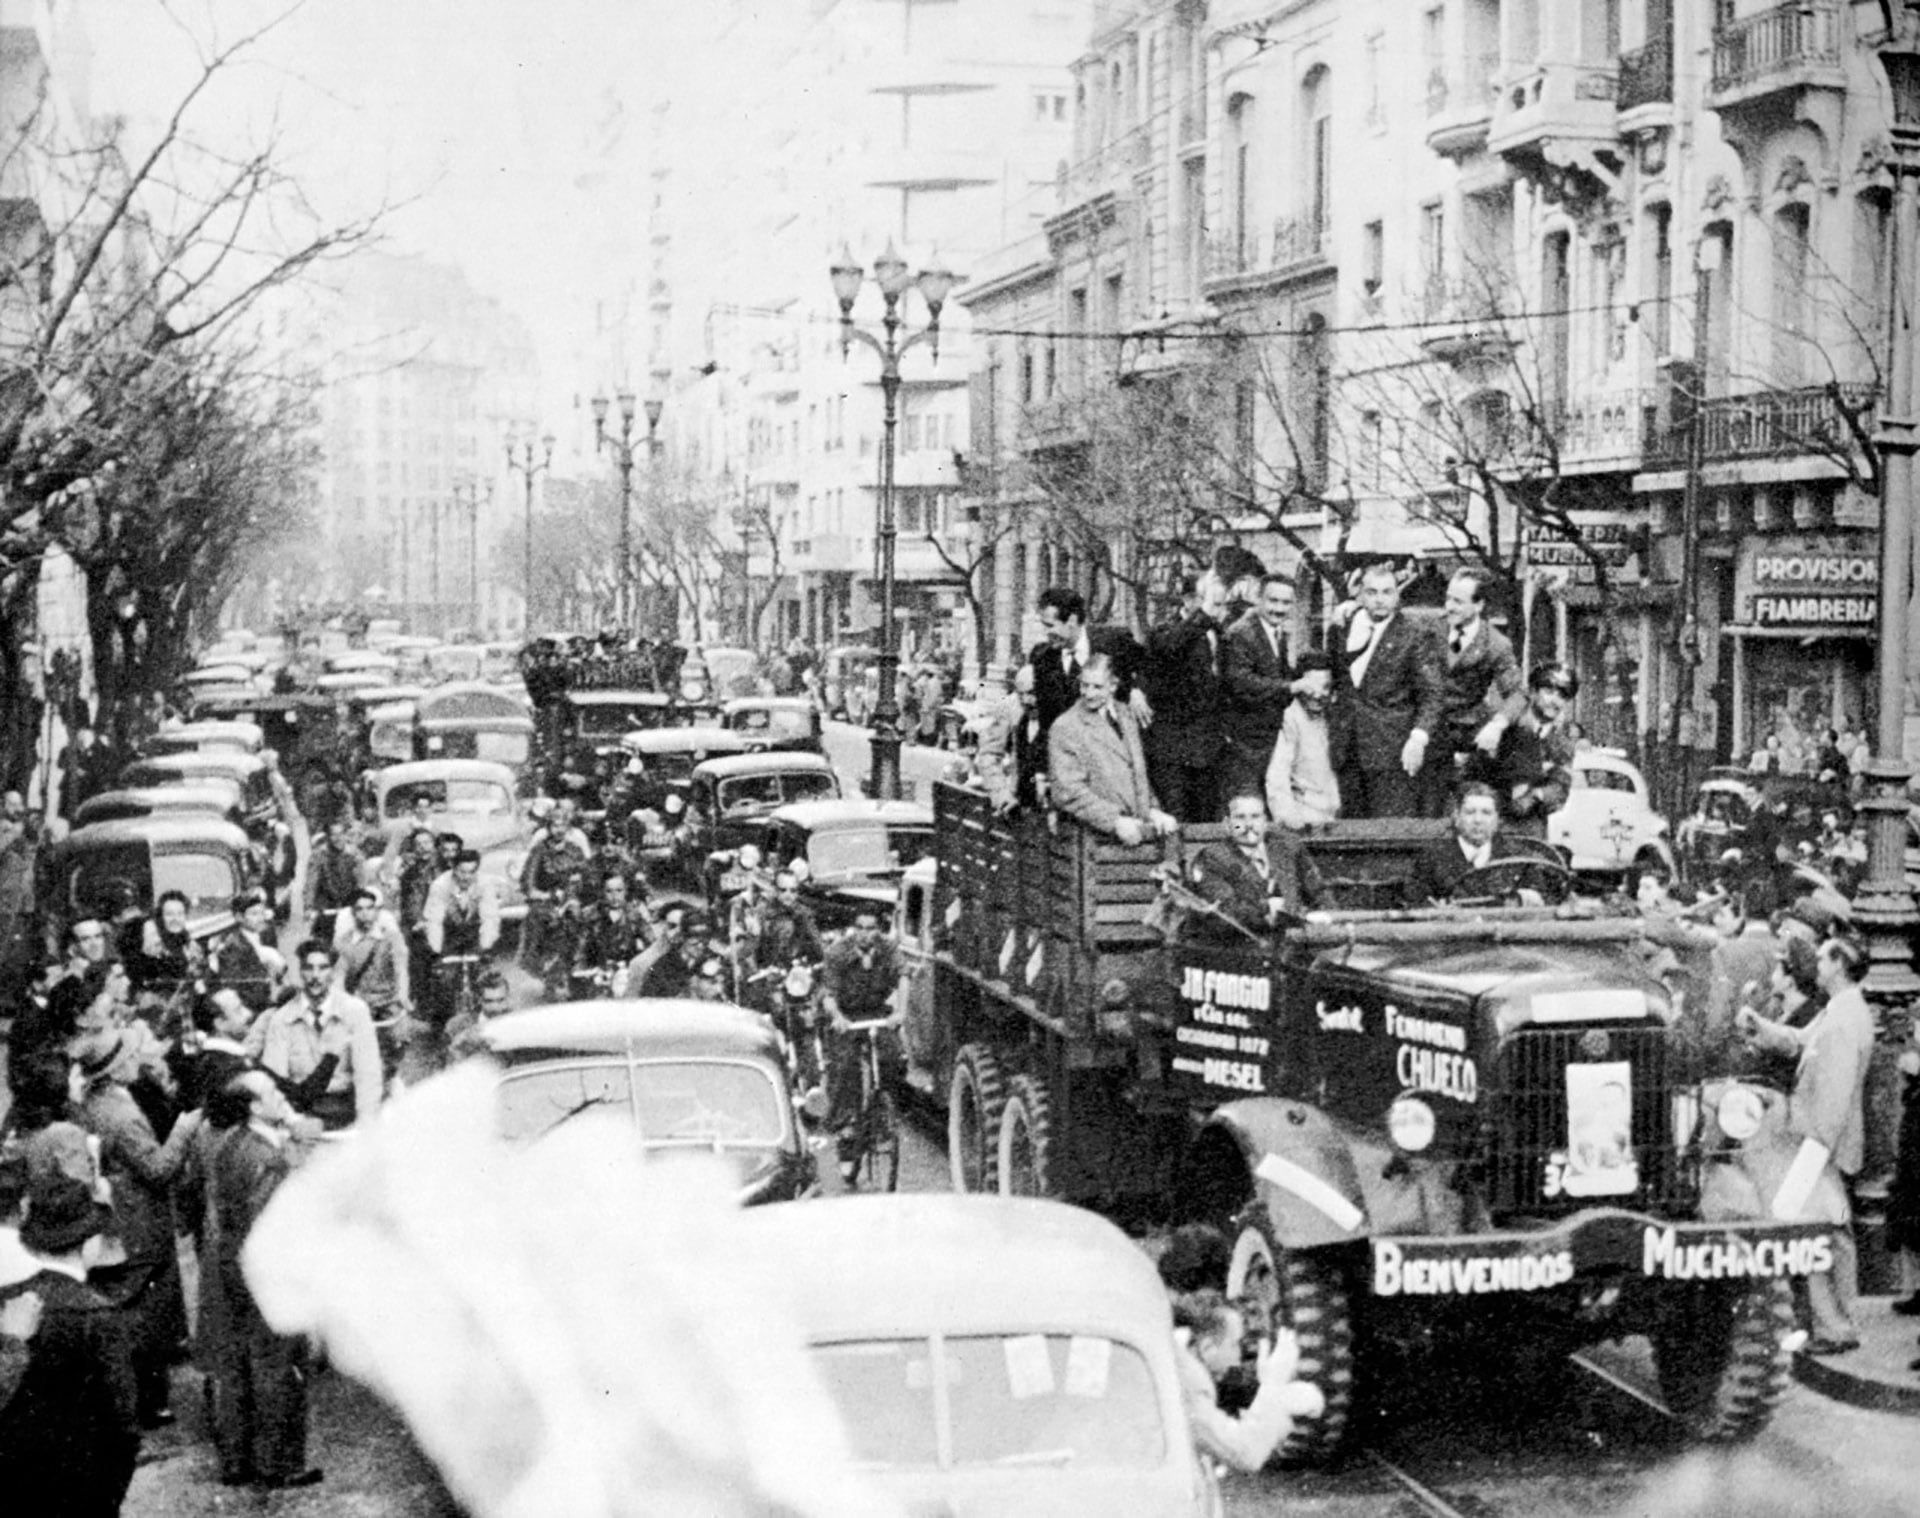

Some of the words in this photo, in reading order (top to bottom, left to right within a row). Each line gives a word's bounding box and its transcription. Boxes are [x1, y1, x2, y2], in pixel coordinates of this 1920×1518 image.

[1204, 970, 1270, 1011] FANGIO
[1204, 1057, 1266, 1092] DIESEL
[1397, 1043, 1477, 1103] CHUECO
[1374, 1241, 1574, 1296] BIENVENIDOS
[1643, 1225, 1833, 1280] MUCHACHOS
